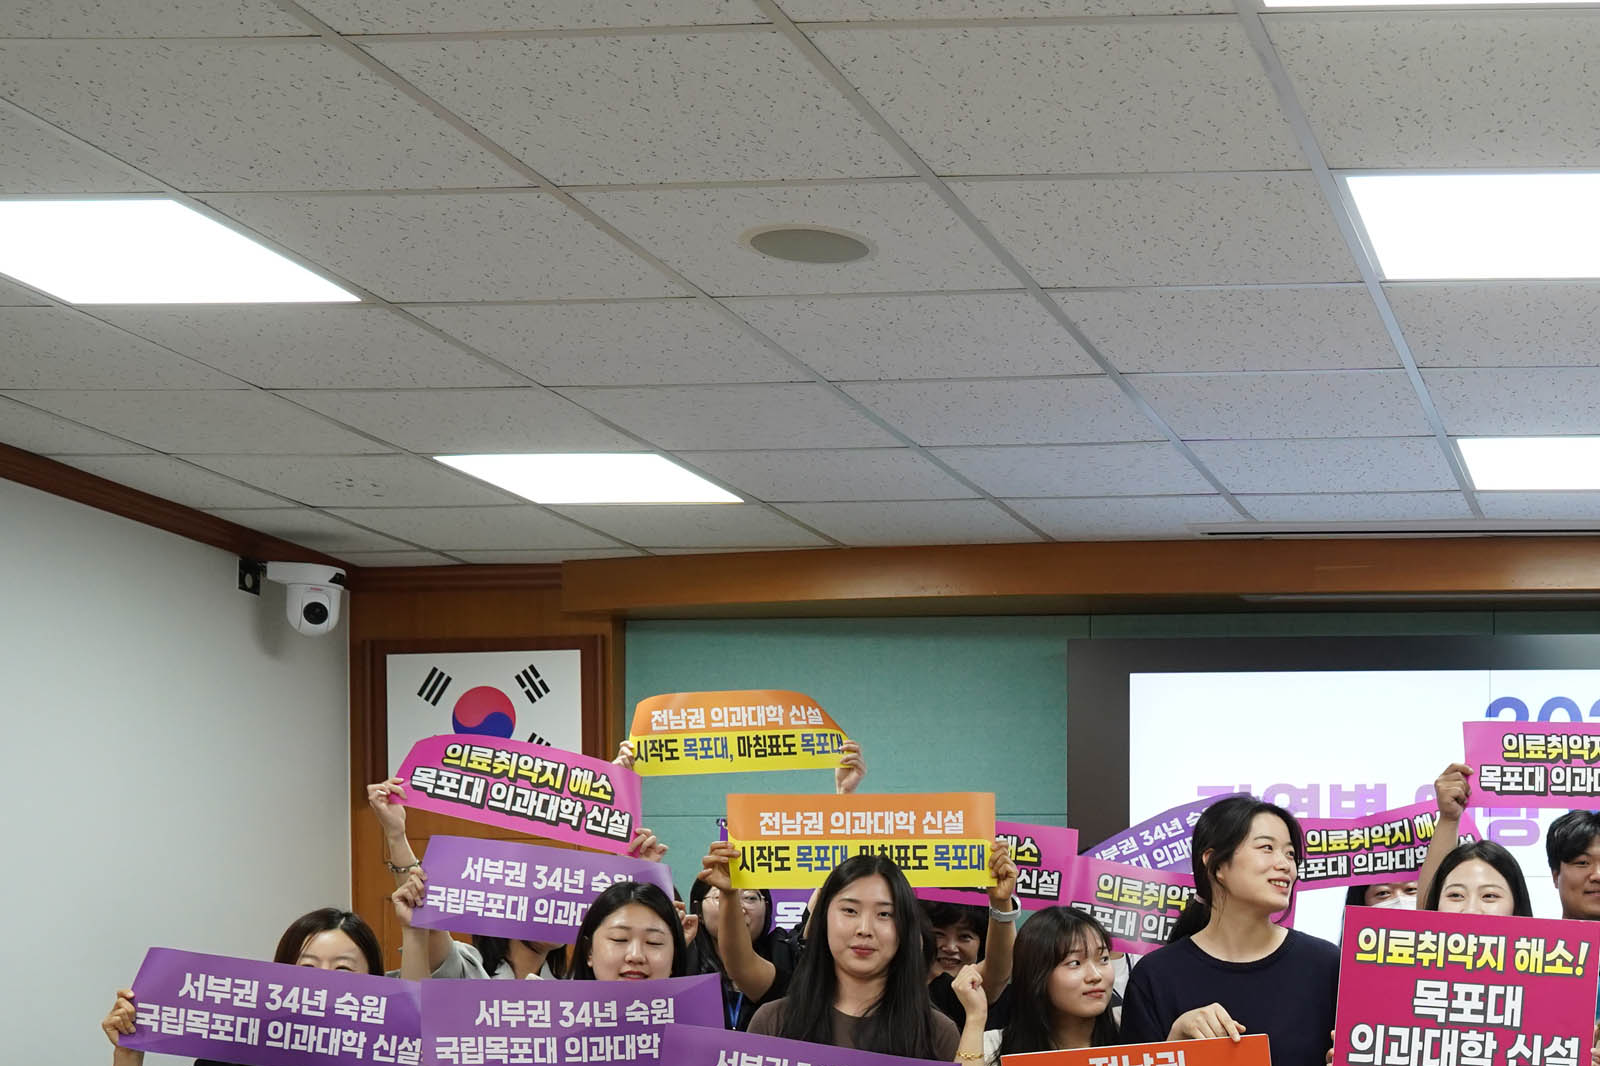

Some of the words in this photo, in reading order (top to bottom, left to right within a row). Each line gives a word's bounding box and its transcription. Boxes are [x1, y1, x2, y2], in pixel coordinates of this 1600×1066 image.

[651, 708, 705, 731] 전남권
[710, 705, 784, 727] 의과대학
[788, 704, 824, 725] 신설
[635, 737, 680, 763] 시작도
[737, 733, 797, 759] 마침표도
[801, 733, 844, 755] 목포대
[443, 743, 566, 789] 의료취약지
[568, 767, 615, 801] 해소
[1480, 765, 1545, 792] 목포대
[411, 766, 486, 804] 목포대
[488, 784, 584, 826] 의과대학
[585, 806, 632, 838] 신설
[759, 811, 824, 836] 전남권
[830, 811, 916, 835] 의과대학
[922, 810, 964, 835] 신설
[1095, 836, 1139, 861] 부권
[1139, 817, 1185, 846] 34년
[1306, 818, 1411, 853] 의료취약지
[739, 845, 791, 873] 시작도
[934, 844, 985, 871] 목포대
[1152, 837, 1193, 868] 의과
[461, 857, 528, 888] 서부권
[533, 864, 585, 894] 34년
[1017, 869, 1060, 896] 신설
[1096, 874, 1197, 911] 의료취약
[427, 885, 529, 922] 국립목포대
[533, 898, 592, 926] 의과
[1355, 927, 1507, 972] 의료취약지
[1513, 937, 1590, 977] 해소!
[179, 972, 260, 1008] 서부권
[265, 983, 328, 1017] 34년
[334, 992, 387, 1024] 숙원
[475, 999, 551, 1028] 서부권
[559, 1000, 618, 1028] 34년
[625, 998, 675, 1025] 숙원
[1413, 979, 1524, 1028] 목포대
[136, 1002, 260, 1045] 국립목포대
[266, 1021, 367, 1059] 의과대학
[372, 1034, 422, 1066] 신설
[435, 1036, 557, 1065] 국립목포대
[564, 1032, 661, 1063] 의과대학
